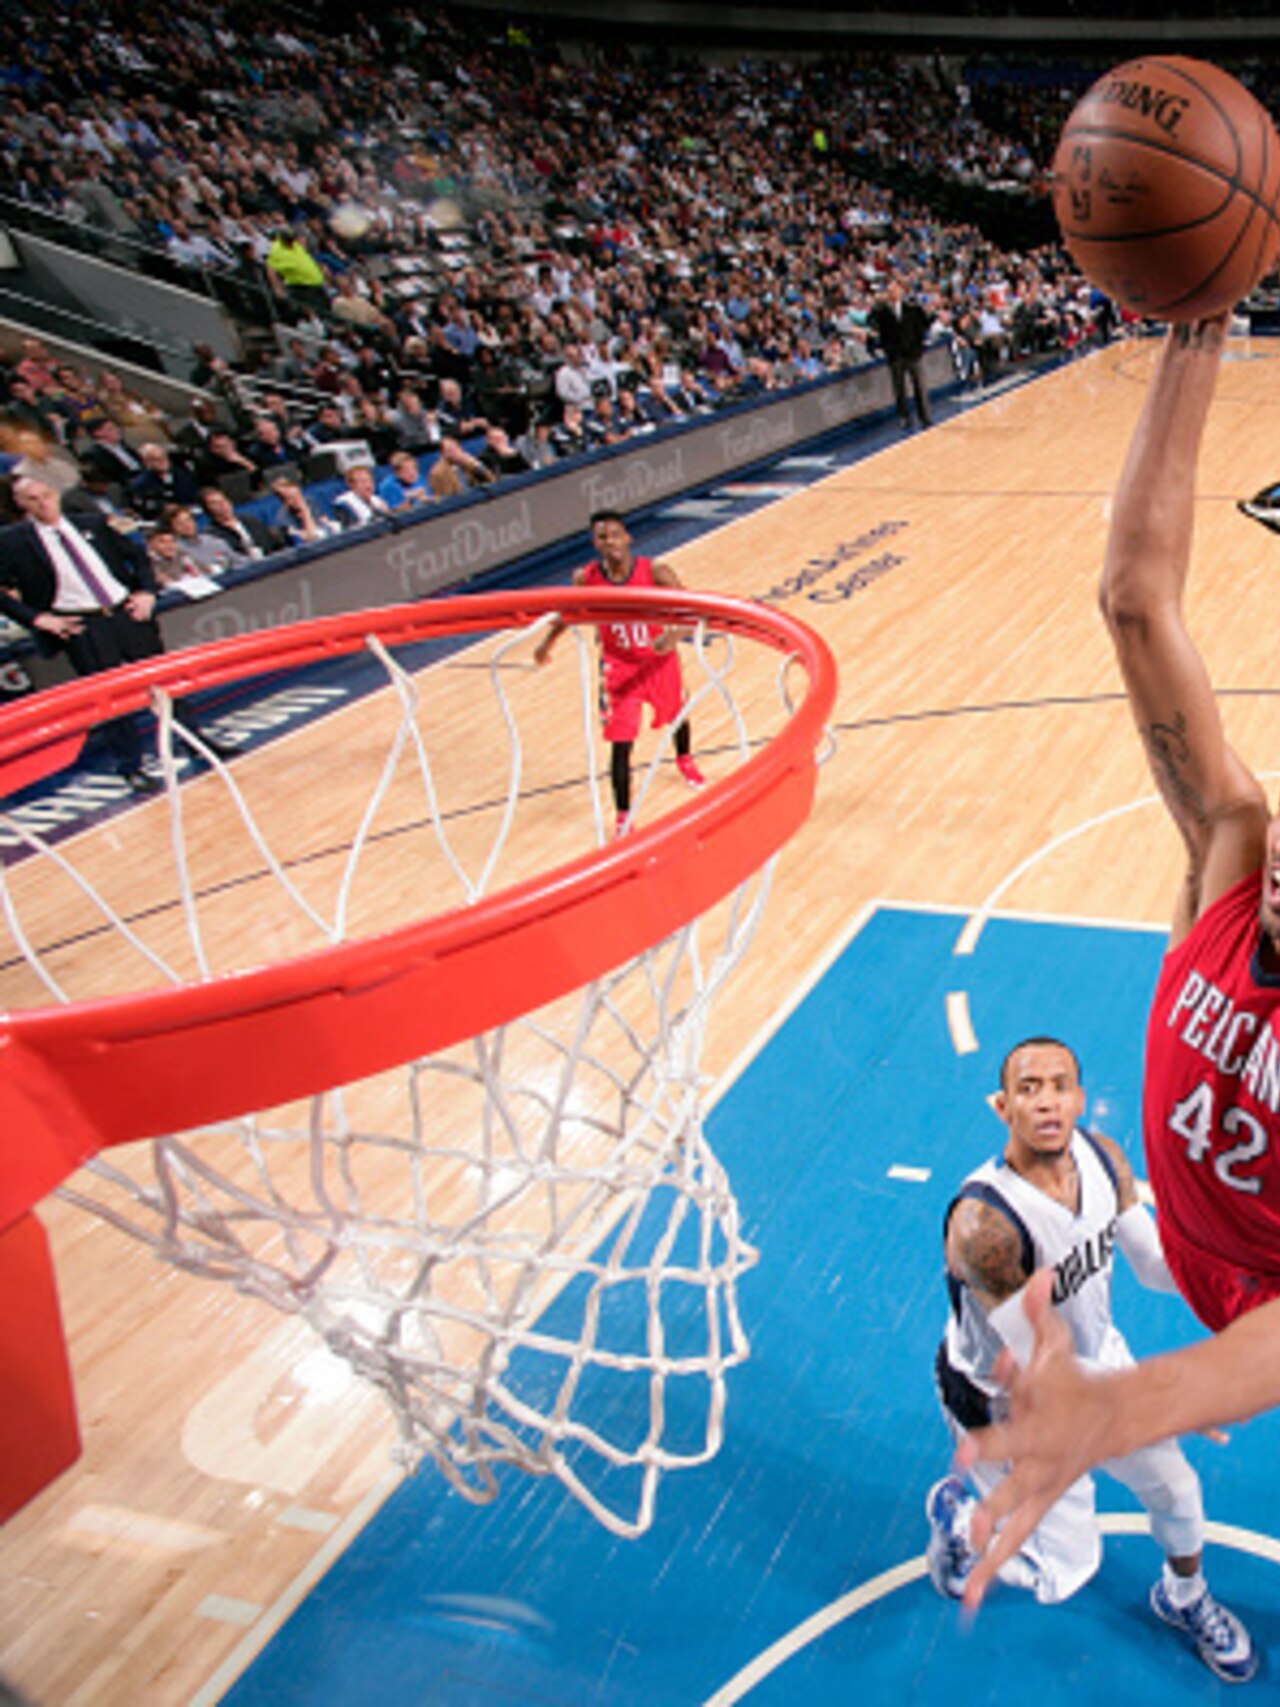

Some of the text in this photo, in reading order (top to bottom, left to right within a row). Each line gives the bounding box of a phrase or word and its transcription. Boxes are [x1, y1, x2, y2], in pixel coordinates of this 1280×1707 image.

[580, 448, 685, 513] FanDuel
[387, 499, 535, 594] FanDuel
[192, 577, 313, 642] Duel
[1167, 1081, 1268, 1194] 42
